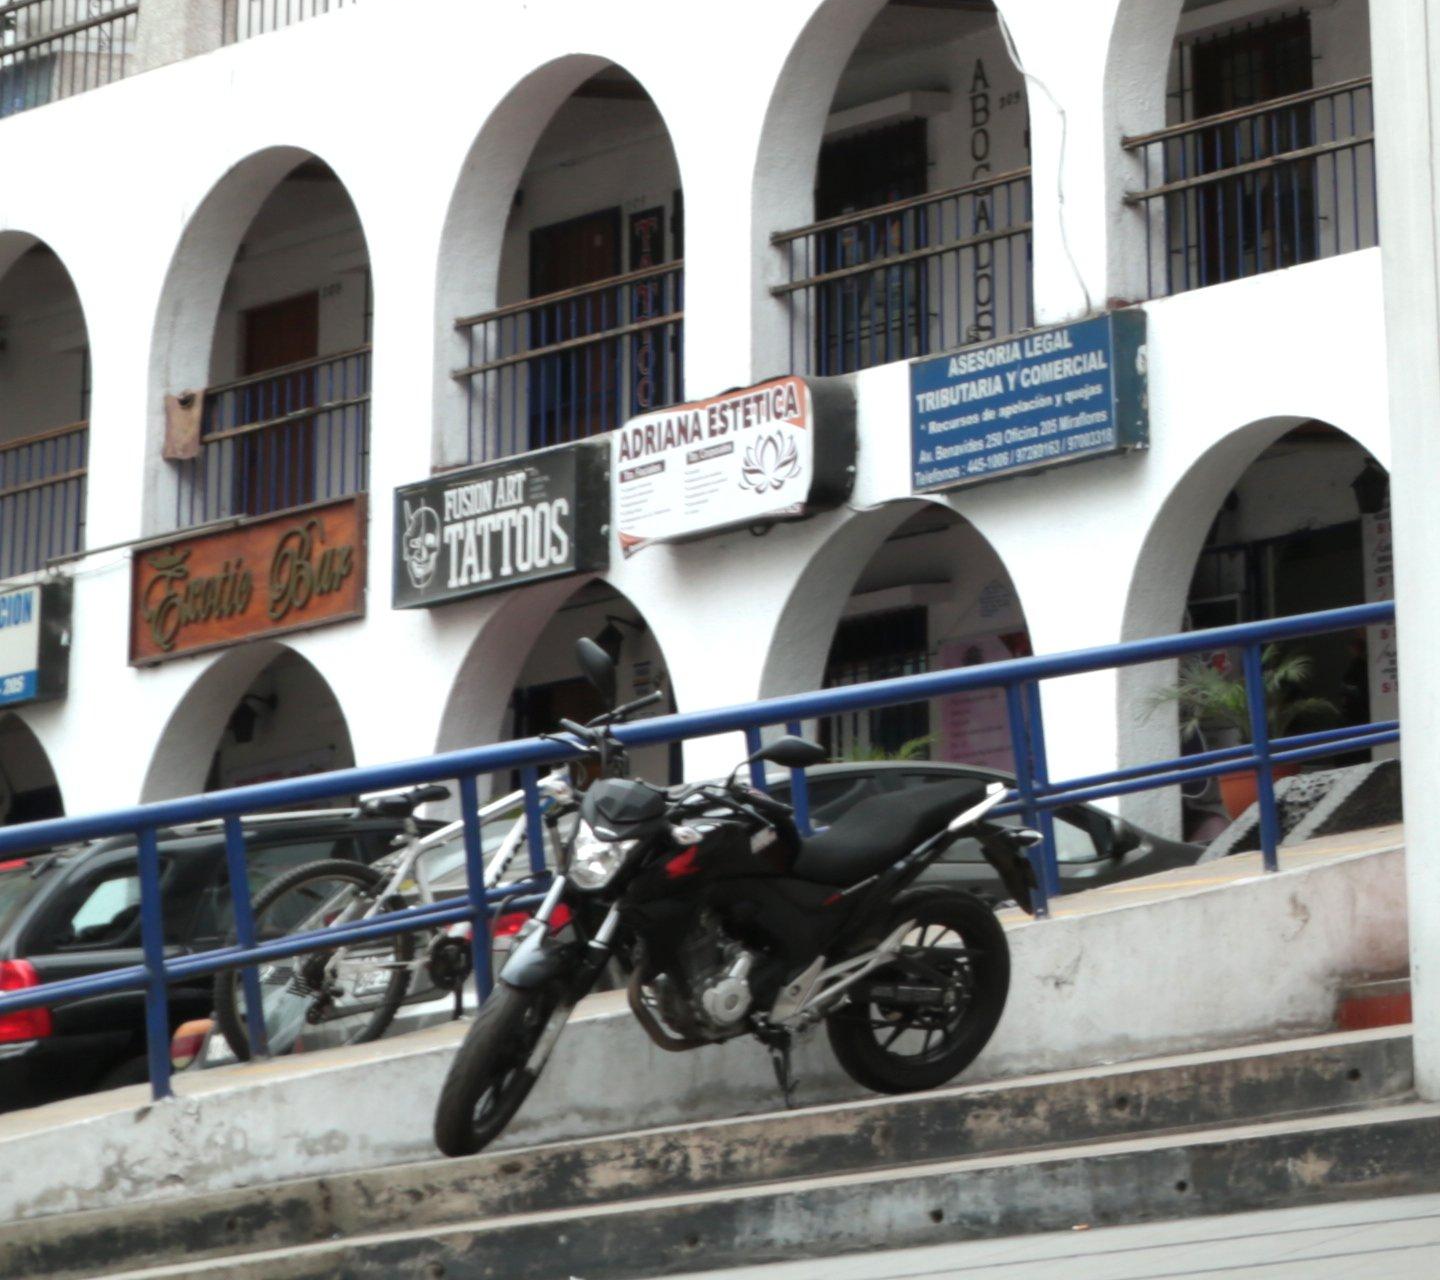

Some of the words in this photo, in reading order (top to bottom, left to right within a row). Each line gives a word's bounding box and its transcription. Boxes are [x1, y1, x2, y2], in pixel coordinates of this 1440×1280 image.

[916, 374, 1004, 414] TRIBUTARIA
[1006, 370, 1018, 392] Y
[1020, 349, 1108, 389] COMERCIAL
[947, 342, 1022, 378] ASESORIA
[1024, 328, 1073, 358] LEGAL
[618, 410, 702, 463] ADRIANA
[706, 383, 799, 439] ESTETICA
[928, 413, 979, 435] Recursos
[981, 407, 996, 422] de
[443, 479, 494, 522] FUSION
[494, 471, 527, 510] ART
[443, 497, 569, 589] TATTOOS
[141, 547, 254, 651] Exotic
[267, 515, 353, 621] Bar
